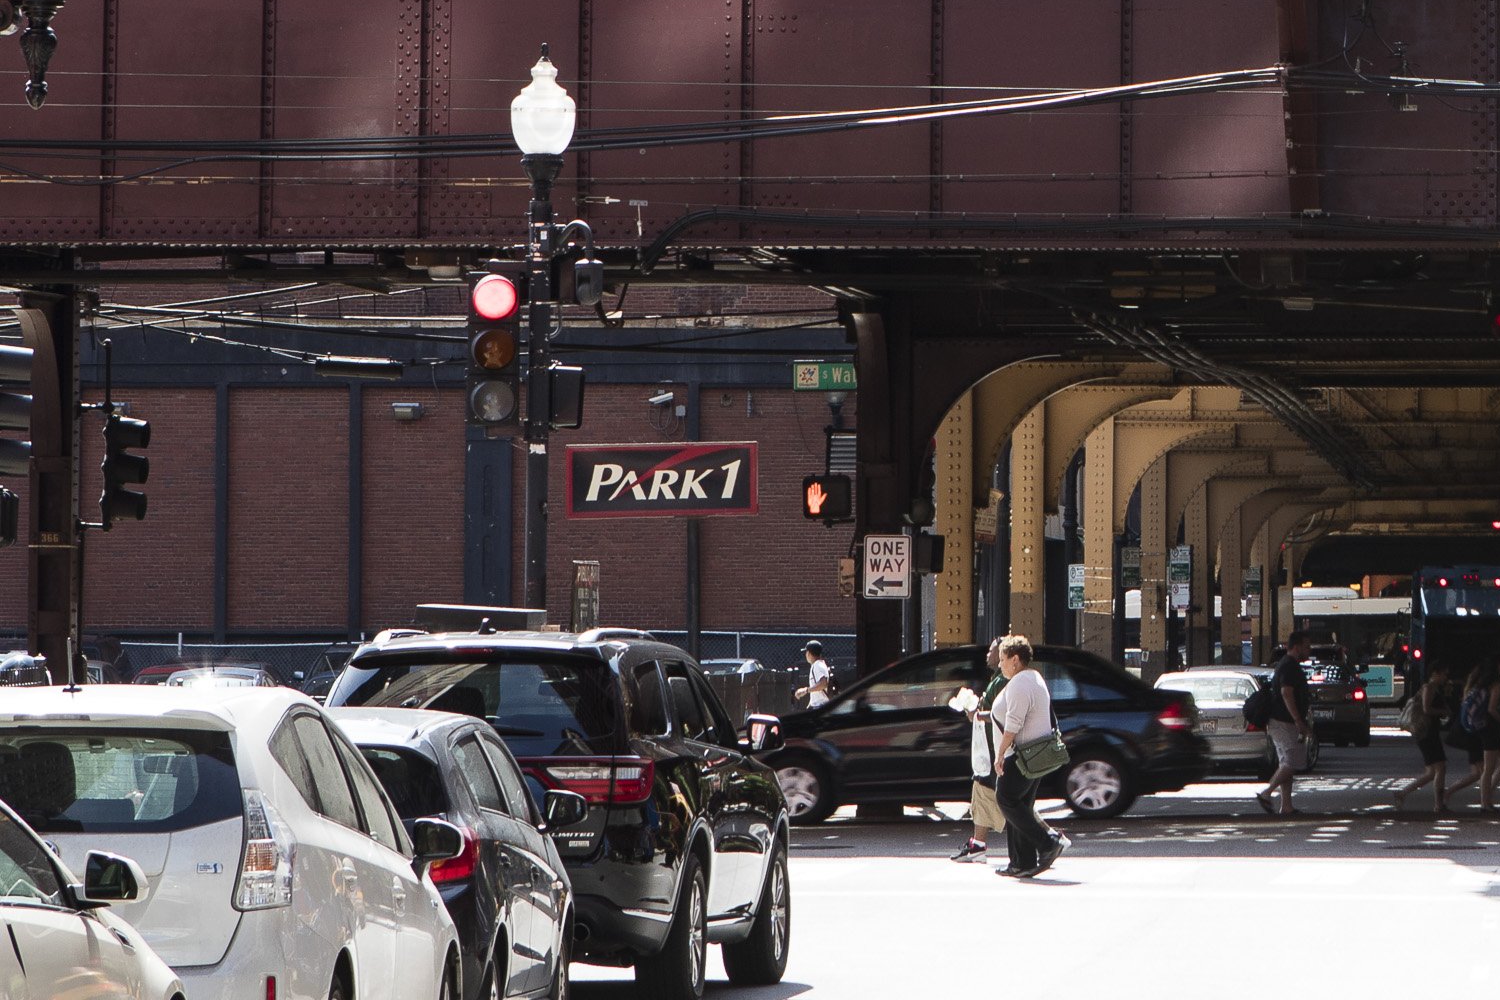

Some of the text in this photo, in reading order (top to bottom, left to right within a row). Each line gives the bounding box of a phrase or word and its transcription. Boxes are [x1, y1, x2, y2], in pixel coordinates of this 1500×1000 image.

[585, 459, 742, 502] PARK 1
[871, 541, 905, 556] ONE
[870, 558, 905, 573] WAY
